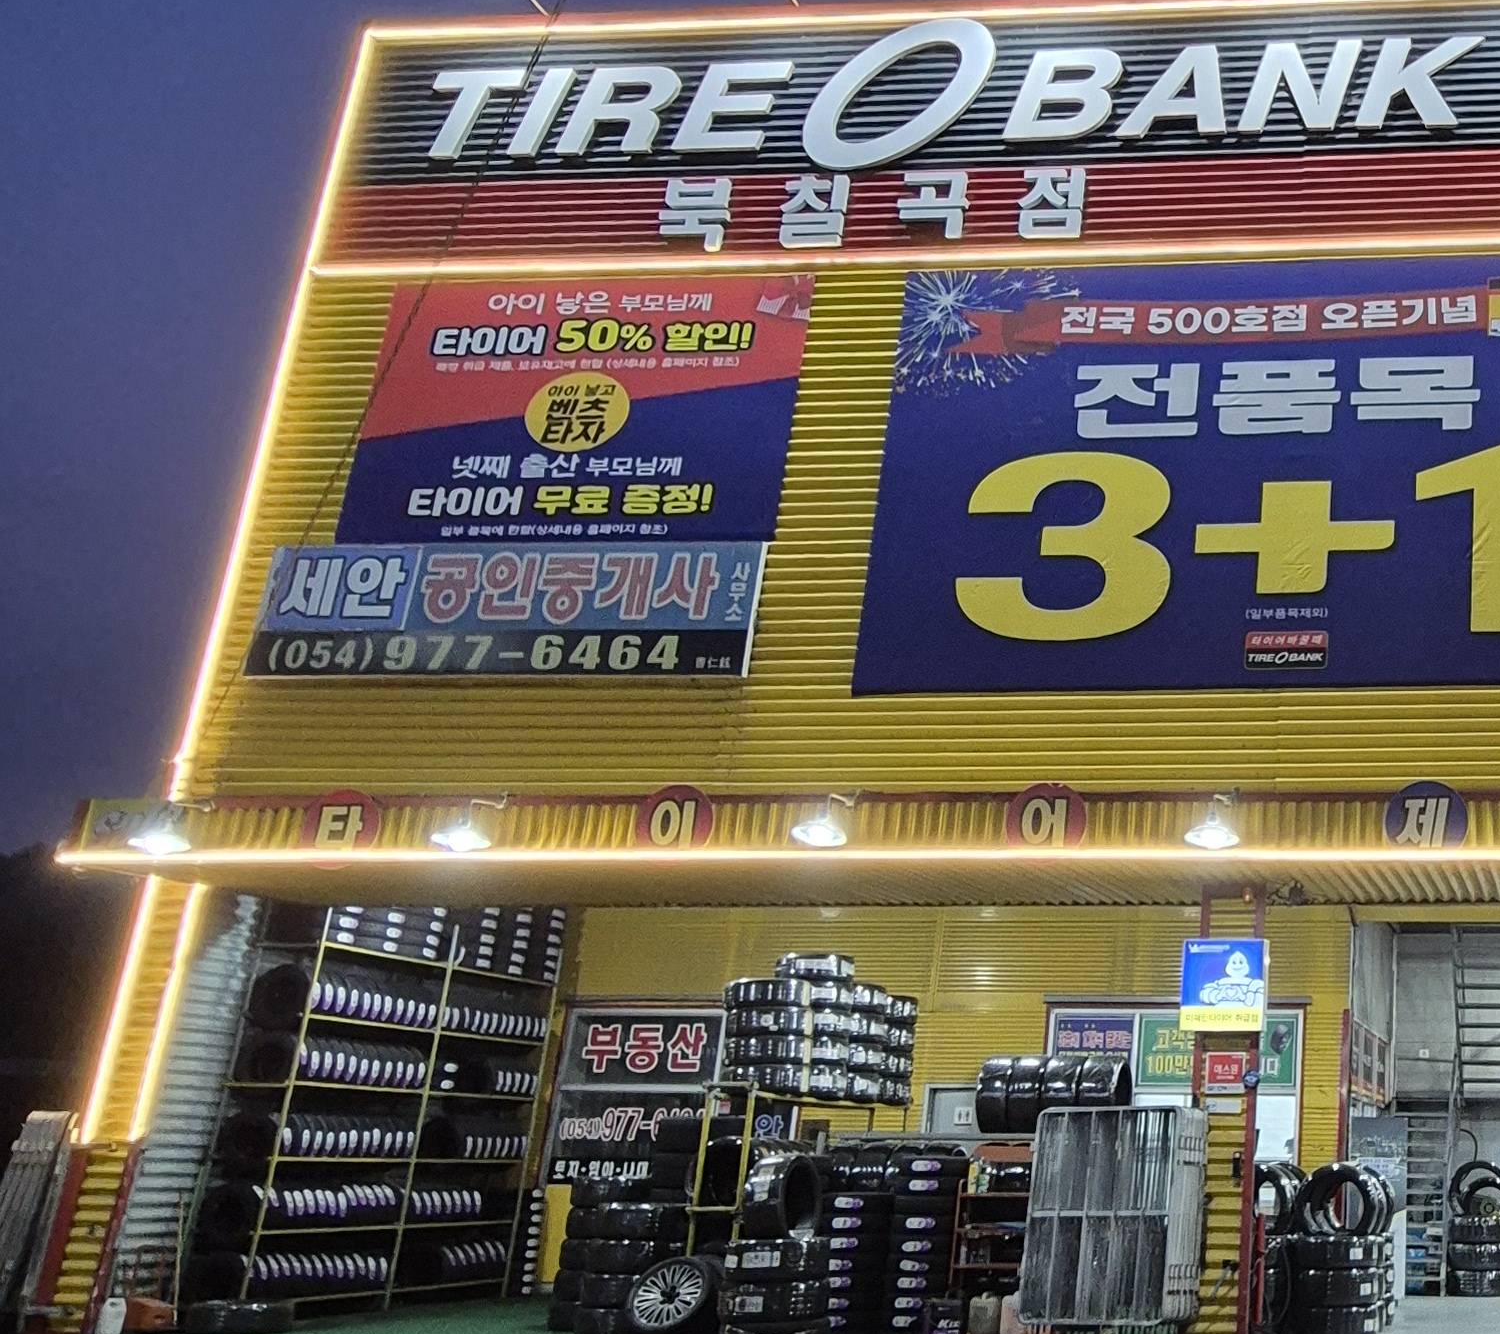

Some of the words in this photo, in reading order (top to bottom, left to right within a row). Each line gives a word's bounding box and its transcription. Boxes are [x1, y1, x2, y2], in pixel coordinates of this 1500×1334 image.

[659, 169, 1086, 251] 북칠곡점
[488, 293, 545, 315] 아이
[618, 293, 713, 313] 부모님께
[1060, 305, 1136, 336] 전국
[1147, 303, 1308, 335] 500호점
[1321, 295, 1478, 332] 오픈기념
[433, 325, 547, 356] 타이어
[555, 319, 653, 352] 50%
[664, 322, 753, 351] 할인!
[548, 385, 579, 397] 아이
[1074, 354, 1482, 439] 전품목
[540, 420, 606, 445] 타자
[451, 455, 511, 479] 넷째
[519, 453, 580, 478] 출산
[585, 455, 682, 476] 부모님께
[407, 485, 524, 517] 타이어
[532, 485, 610, 515] 무료
[621, 483, 713, 514] 증정!
[281, 556, 406, 620] 세안
[421, 551, 722, 627] 공인중개사
[724, 562, 750, 622] 사무소
[582, 1023, 707, 1073] 부동산
